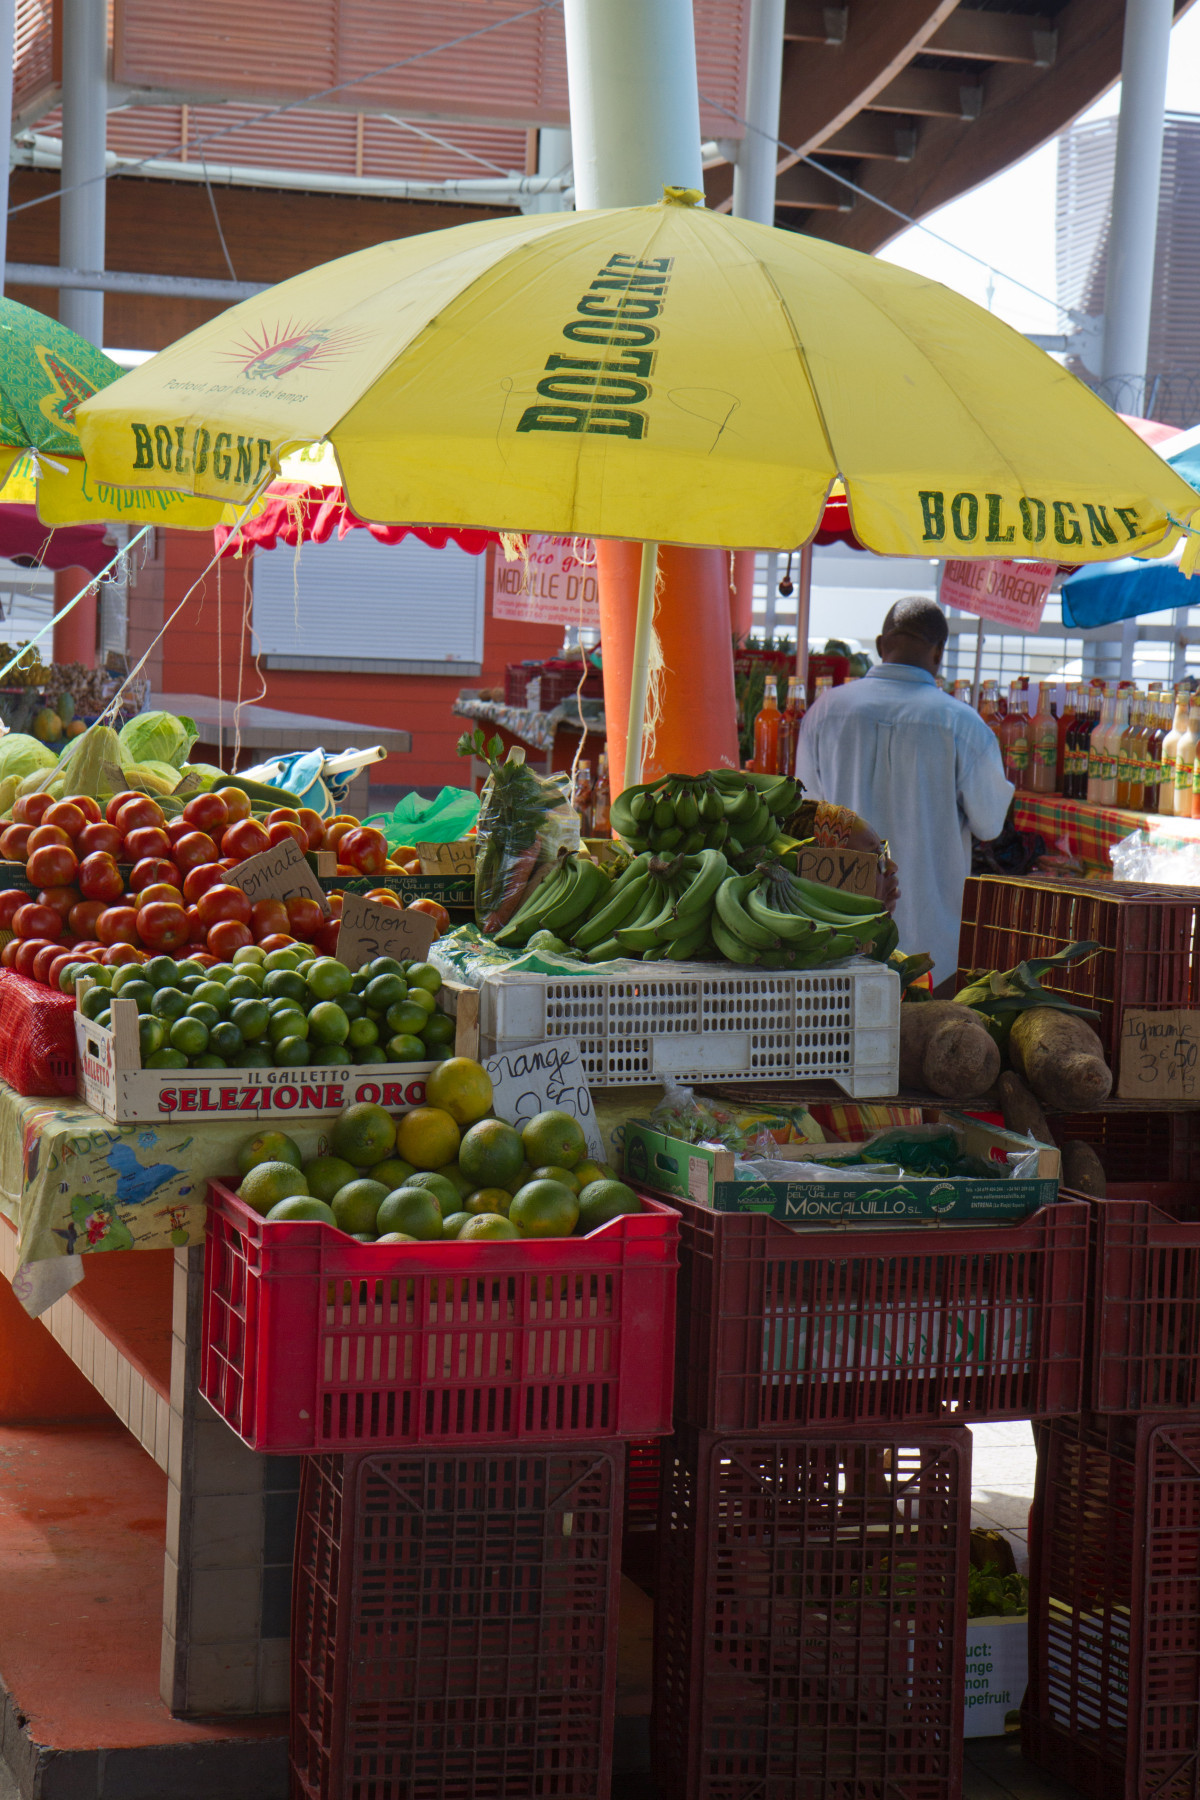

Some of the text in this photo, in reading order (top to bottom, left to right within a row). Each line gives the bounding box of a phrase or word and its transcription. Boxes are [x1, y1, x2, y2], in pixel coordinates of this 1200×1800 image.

[515, 252, 675, 440] BOLOGNE
[206, 384, 231, 394] par
[231, 384, 256, 396] tous
[256, 386, 274, 398] les
[274, 390, 309, 404] temps
[131, 422, 271, 485] BOLOGNE
[918, 490, 1147, 546] BOLOGNE
[229, 848, 305, 896] Tomate
[158, 1081, 427, 1112] SELEZIONE ORO
[248, 1070, 350, 1084] IL GALLETTO
